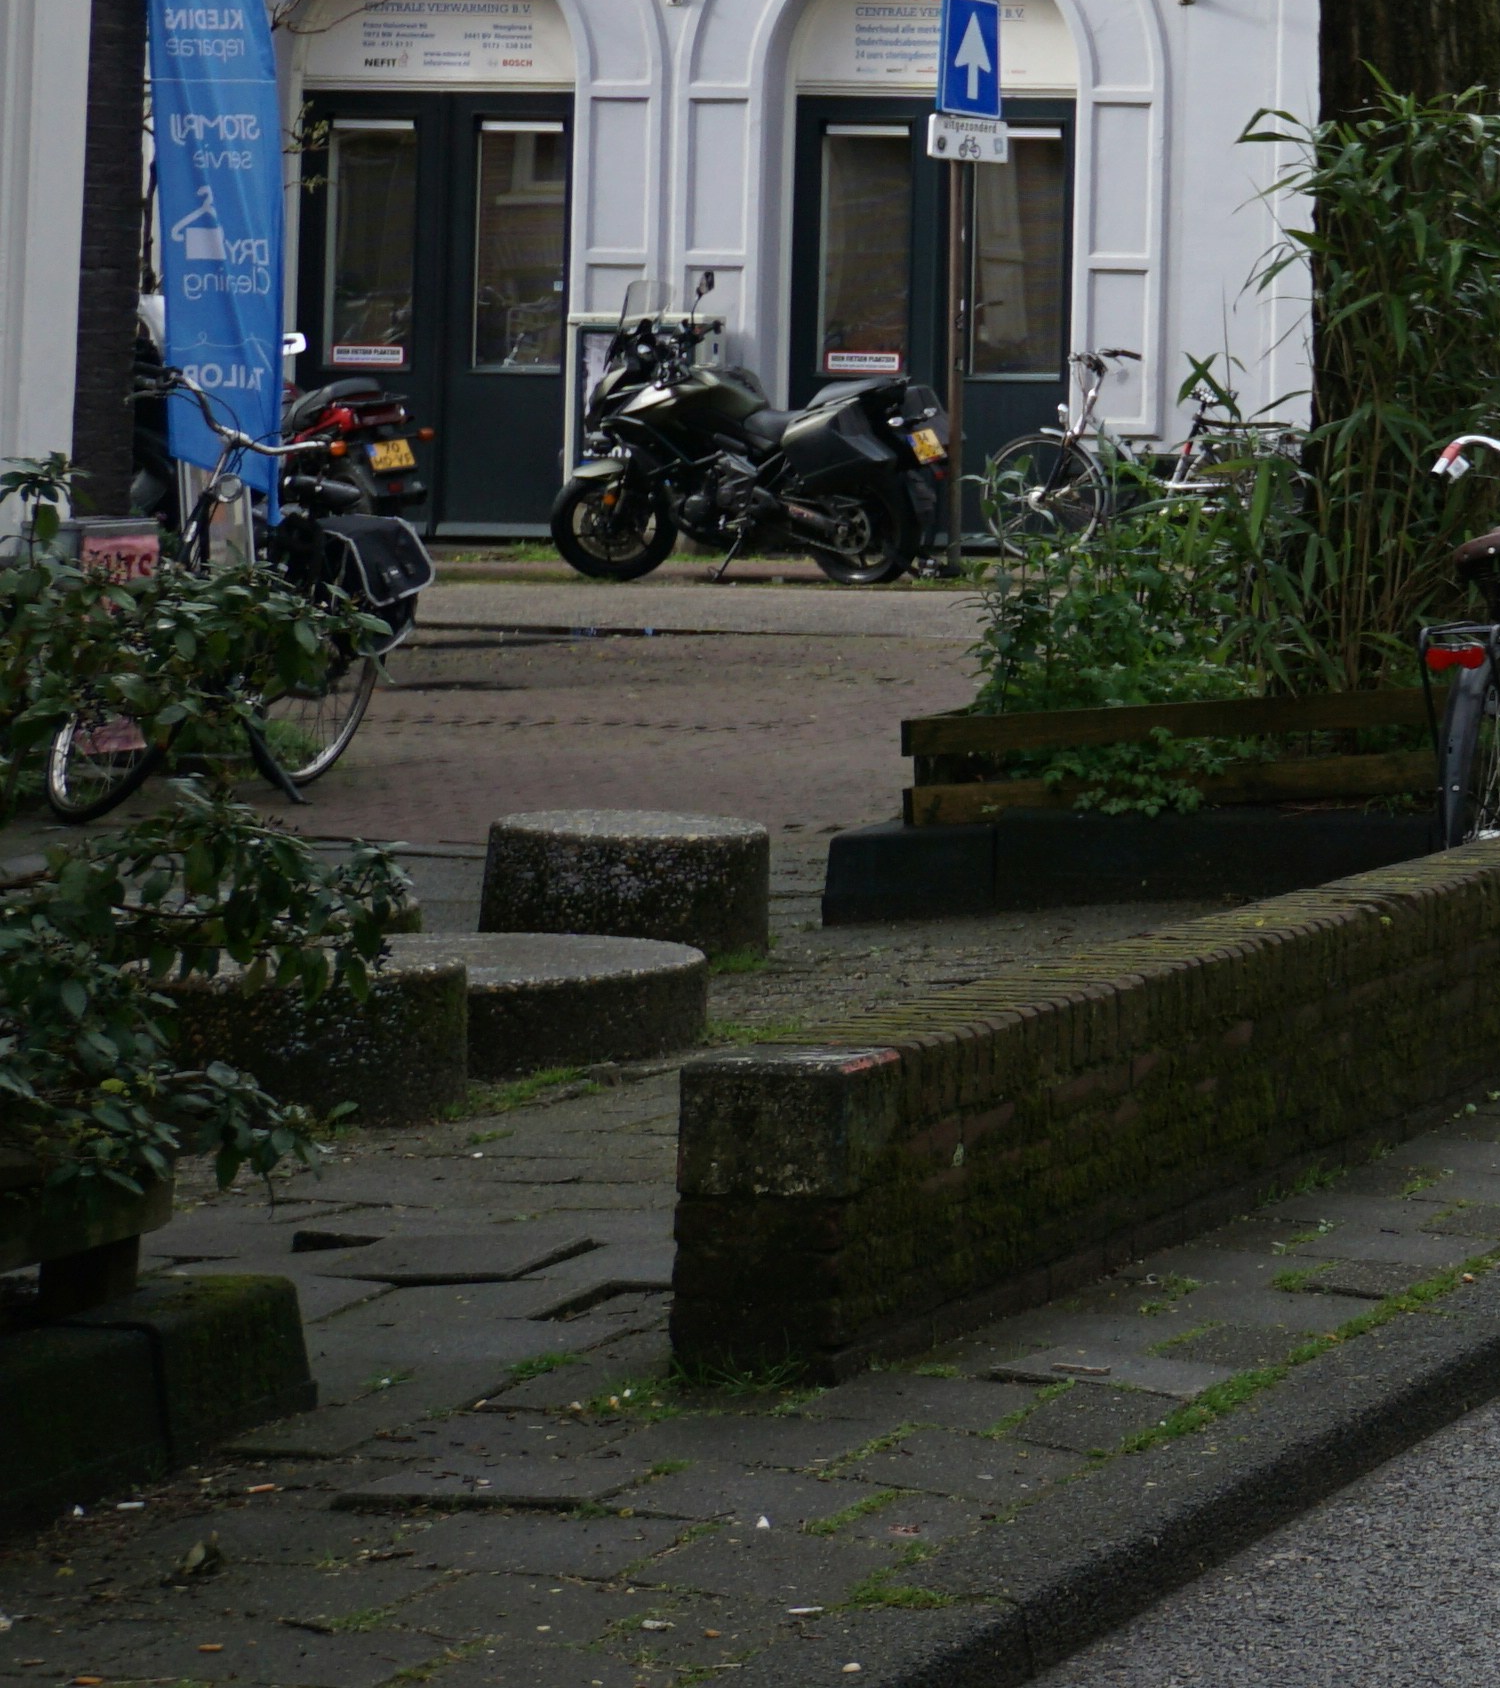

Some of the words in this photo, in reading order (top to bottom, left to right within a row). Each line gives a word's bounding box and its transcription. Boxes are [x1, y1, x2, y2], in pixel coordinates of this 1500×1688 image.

[428, 2, 509, 13] VERWARMING
[855, 7, 918, 17] CENTRALE
[364, 58, 397, 67] NEFIT
[944, 120, 997, 133] uitgezonderd
